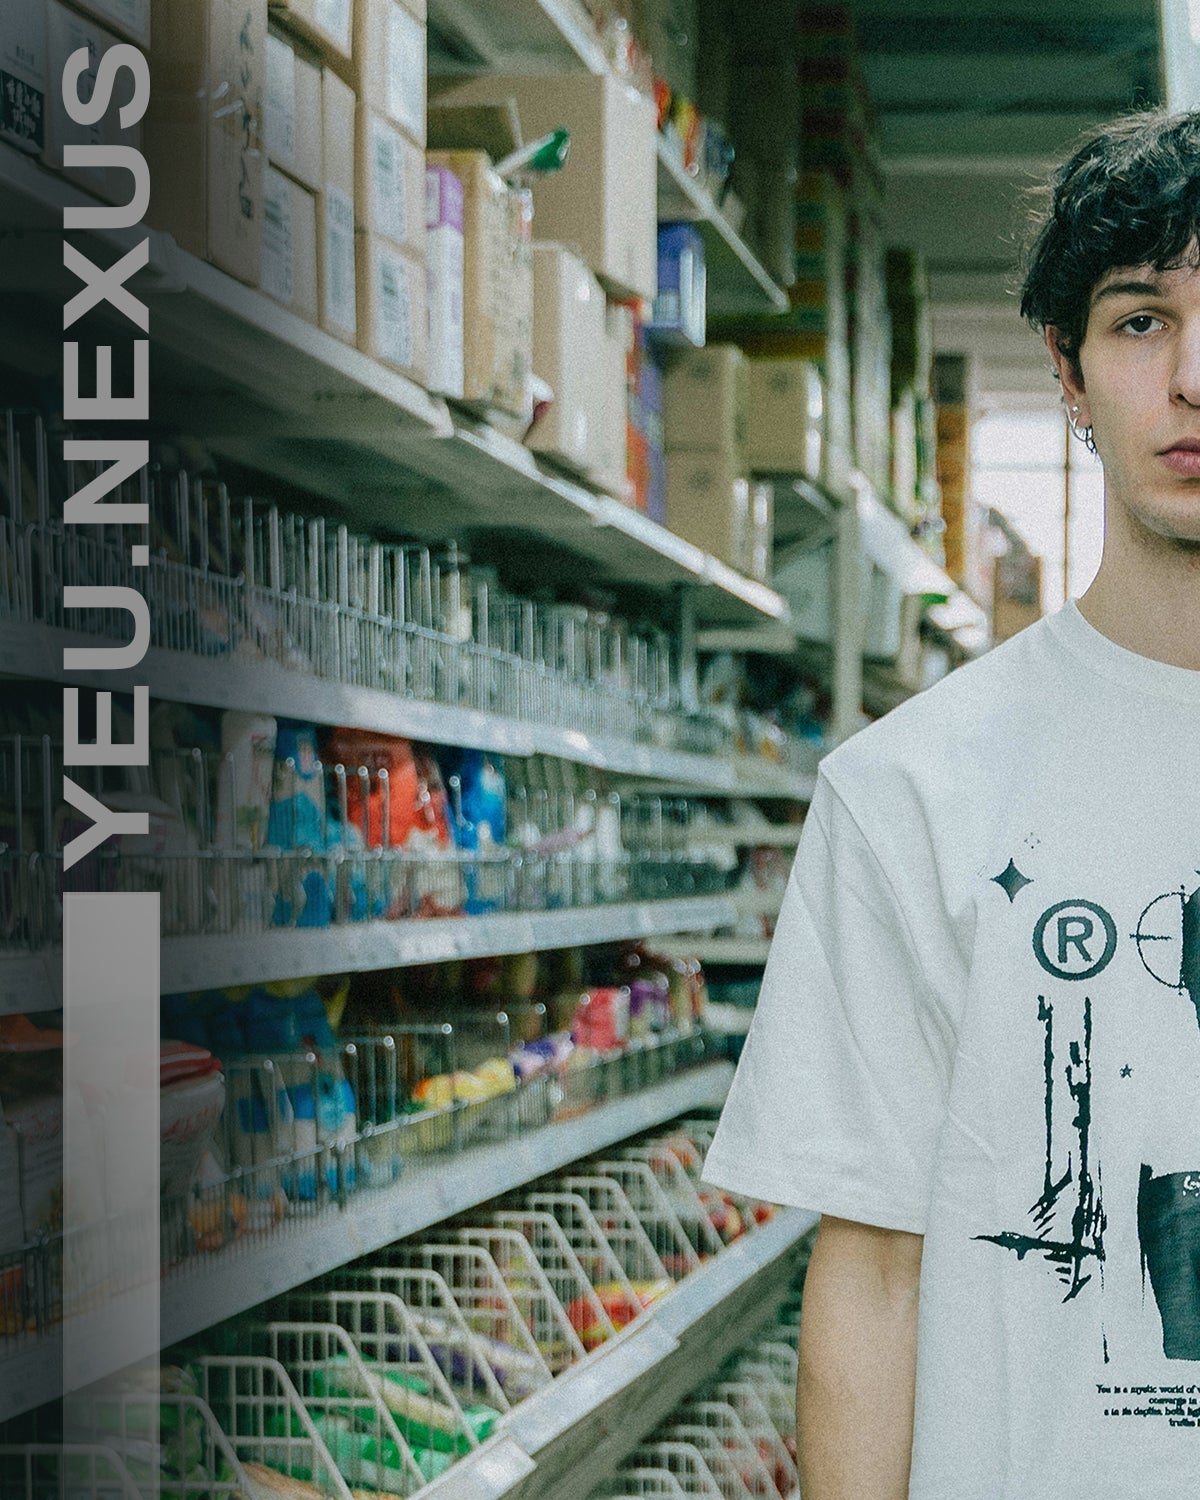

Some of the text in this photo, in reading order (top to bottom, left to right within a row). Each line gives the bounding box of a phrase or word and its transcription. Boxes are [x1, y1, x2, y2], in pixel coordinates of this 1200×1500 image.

[1114, 1386, 1121, 1394] is
[1130, 1385, 1157, 1395] mystic
[1159, 1385, 1184, 1394] world
[1186, 1385, 1196, 1393] of
[1189, 1397, 1197, 1405] in
[1111, 1408, 1119, 1416] in
[1165, 1407, 1185, 1416] both
[1169, 1418, 1195, 1427] truths
